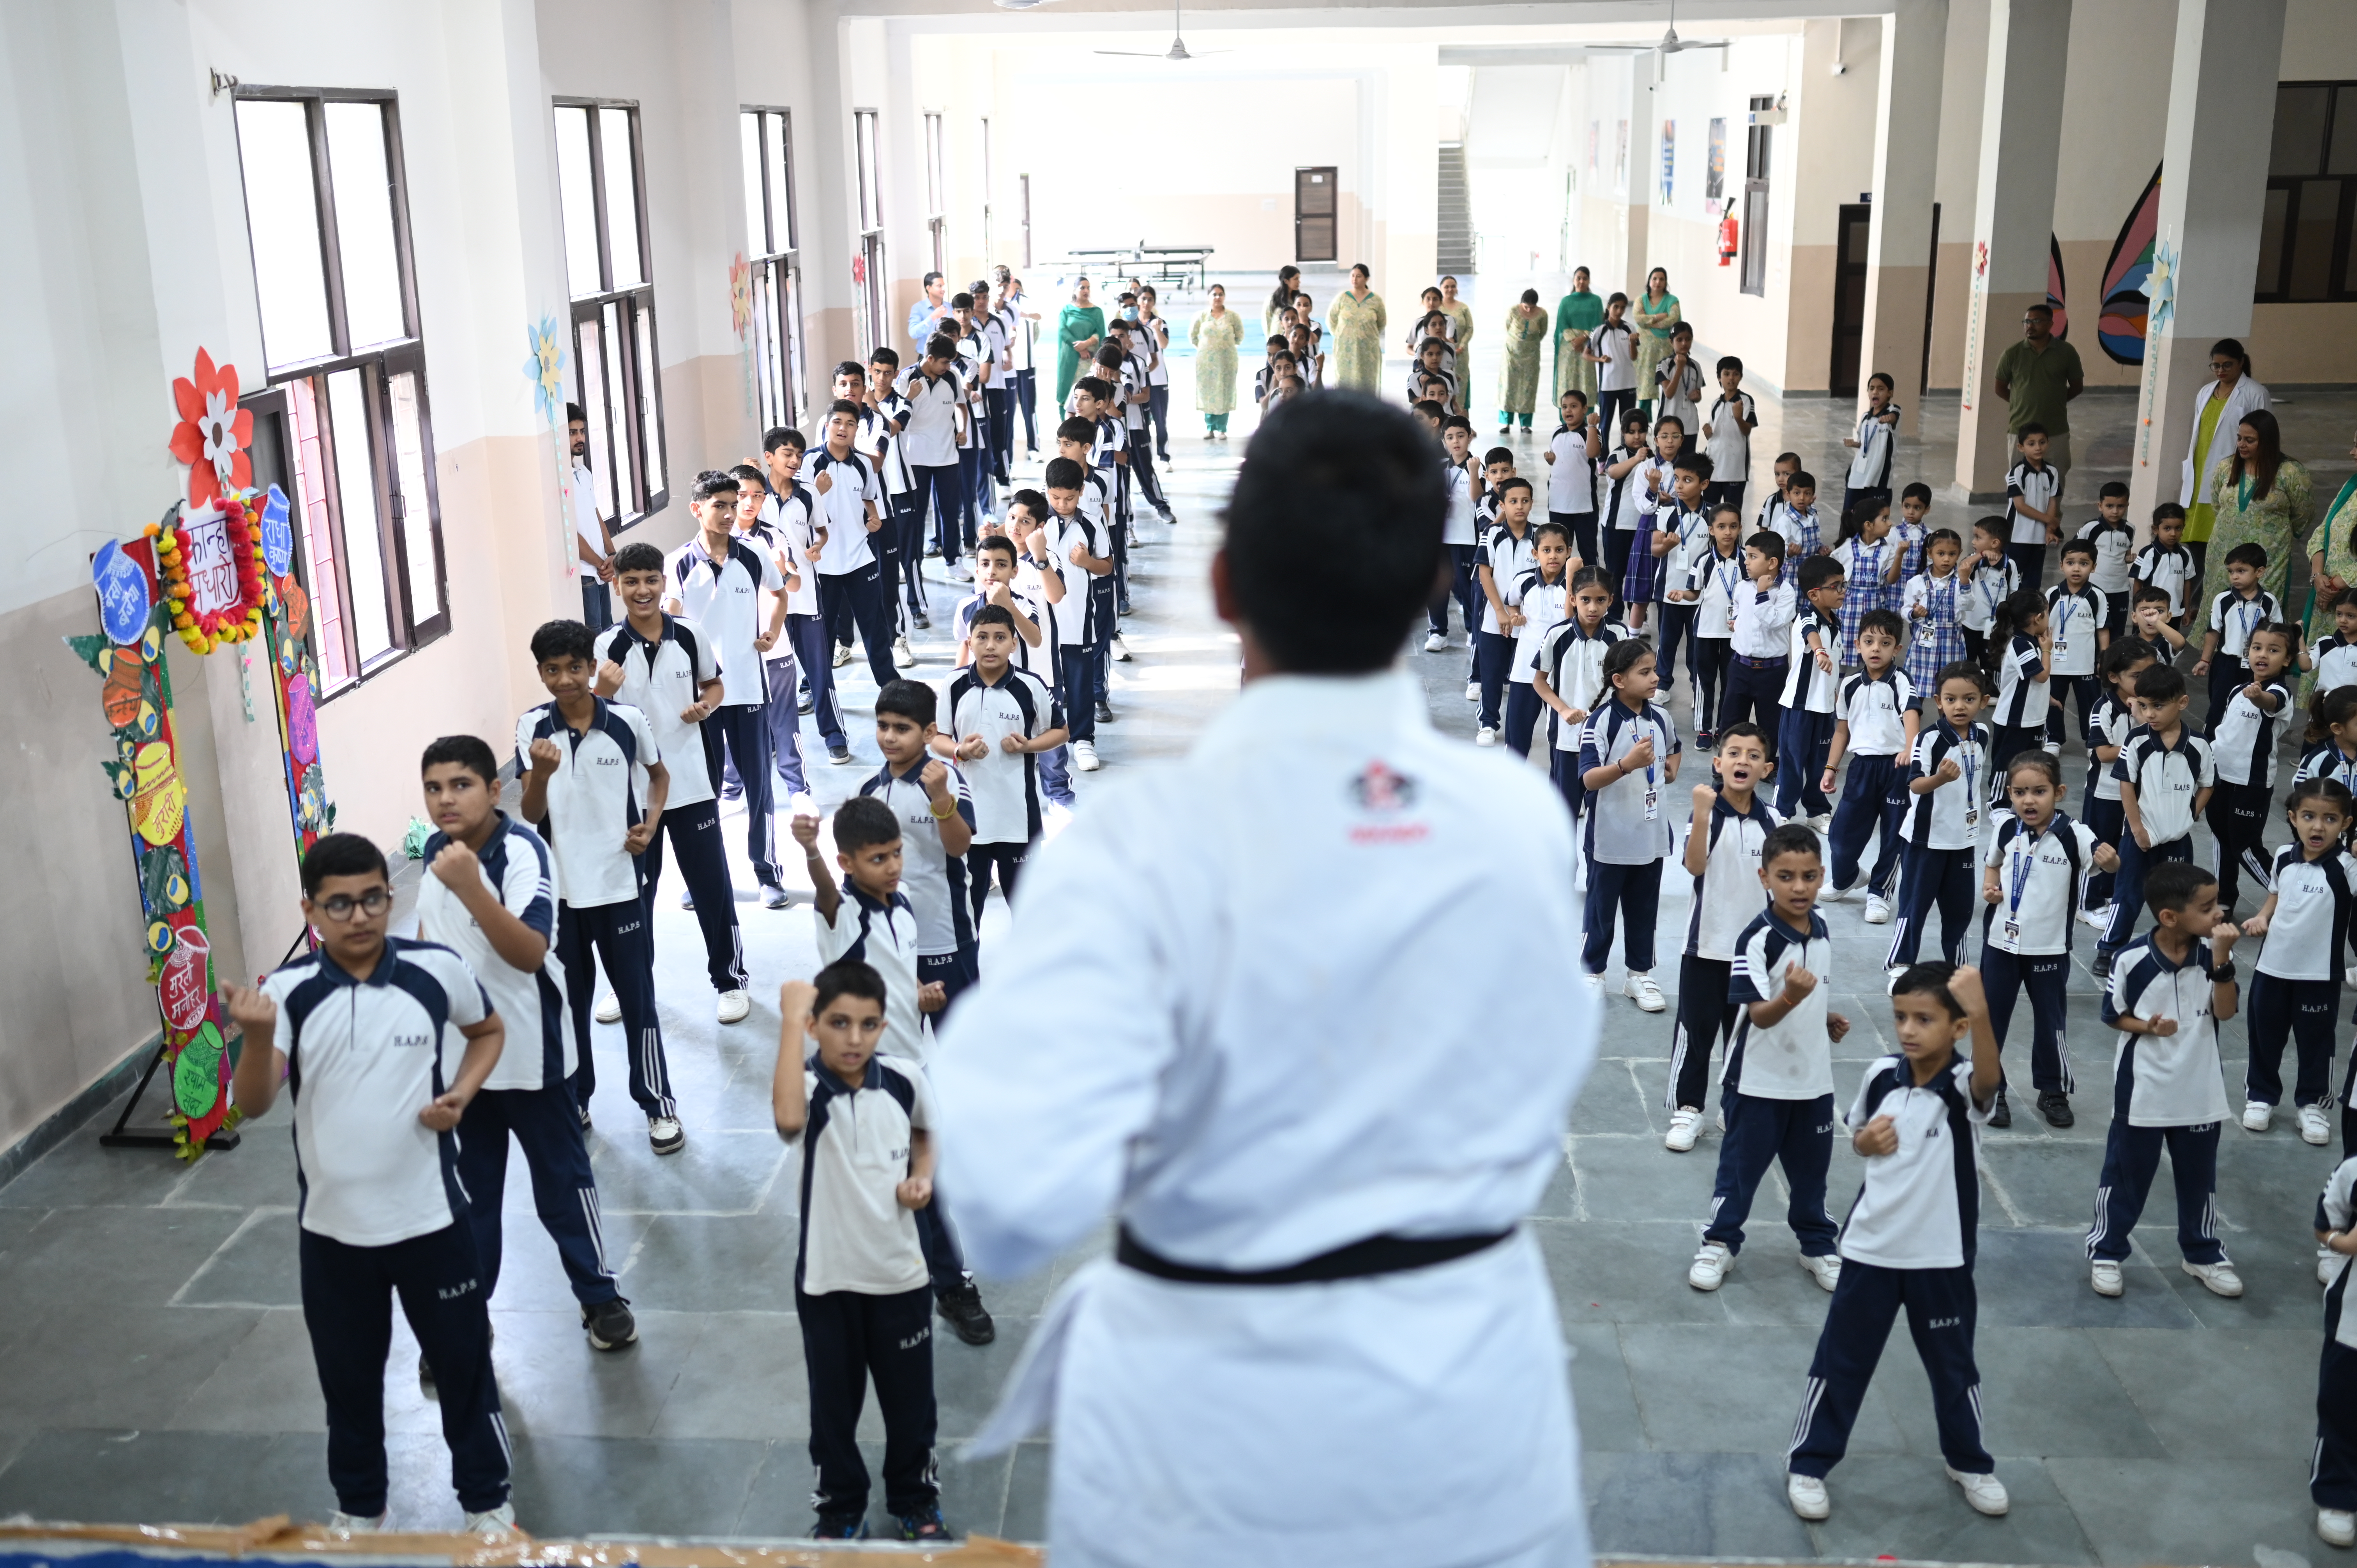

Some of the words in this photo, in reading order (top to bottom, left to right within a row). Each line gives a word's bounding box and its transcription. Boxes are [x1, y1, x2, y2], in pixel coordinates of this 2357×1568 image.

[264, 519, 288, 547] राधा
[1905, 550, 1921, 559] HAP
[999, 712, 1019, 720] H.A.P.S
[2241, 711, 2258, 719] H.A.P.S
[2235, 808, 2255, 817] H.A.P.S
[698, 818, 715, 830] H.A.P.S
[2042, 855, 2067, 865] H.A.P.S
[2303, 885, 2323, 893] H.A.P.S
[618, 921, 640, 934] H.A.P.S
[927, 955, 952, 966] H.A.P.S
[2034, 963, 2058, 973] H.A.P.S
[171, 990, 201, 1019] मनोहर
[1816, 1121, 1834, 1134] H.A.P
[438, 1280, 476, 1300] H.A.P.S
